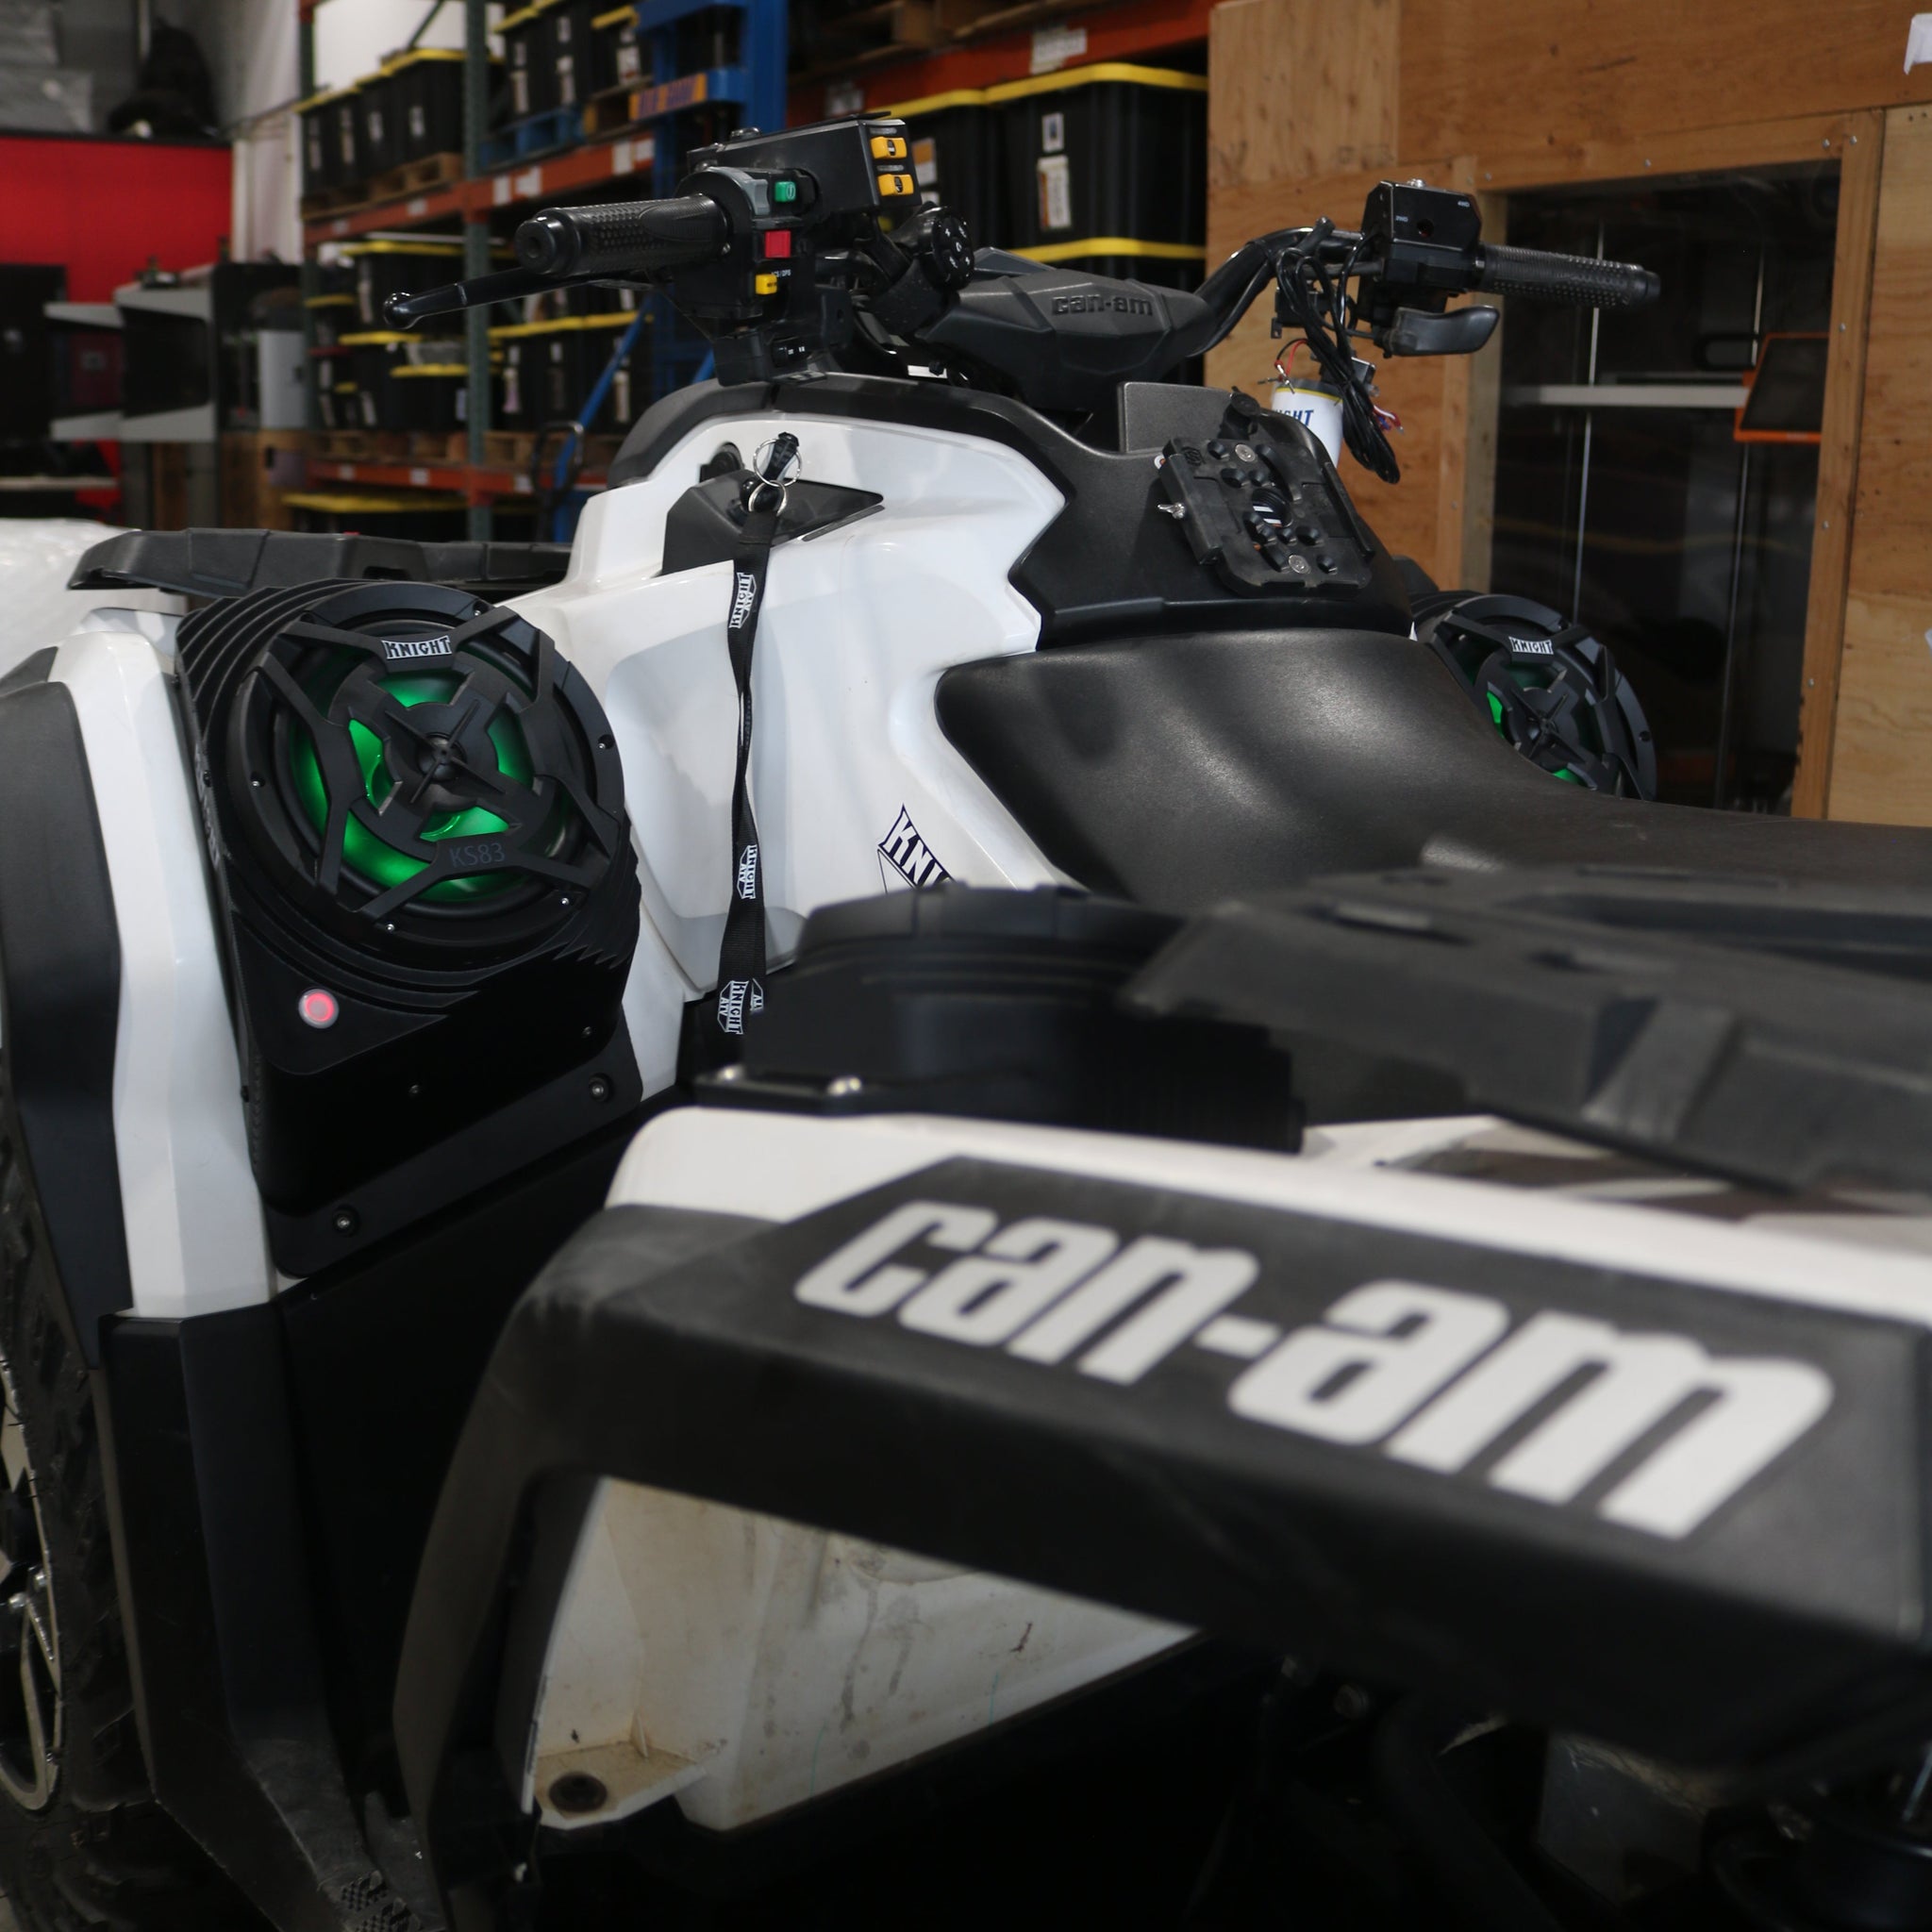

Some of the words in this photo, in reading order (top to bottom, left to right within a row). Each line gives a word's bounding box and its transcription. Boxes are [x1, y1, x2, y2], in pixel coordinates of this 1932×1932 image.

[1052, 294, 1153, 315] can-am
[730, 573, 752, 628] KNIGHT
[382, 636, 451, 658] KNIGHT
[1509, 637, 1554, 655] KNIGHT
[449, 842, 506, 867] KS83
[742, 844, 758, 899] KNIGHT
[880, 808, 955, 888] KNI
[726, 980, 748, 1034] KNIGHT
[795, 1200, 1833, 1540] can-am
